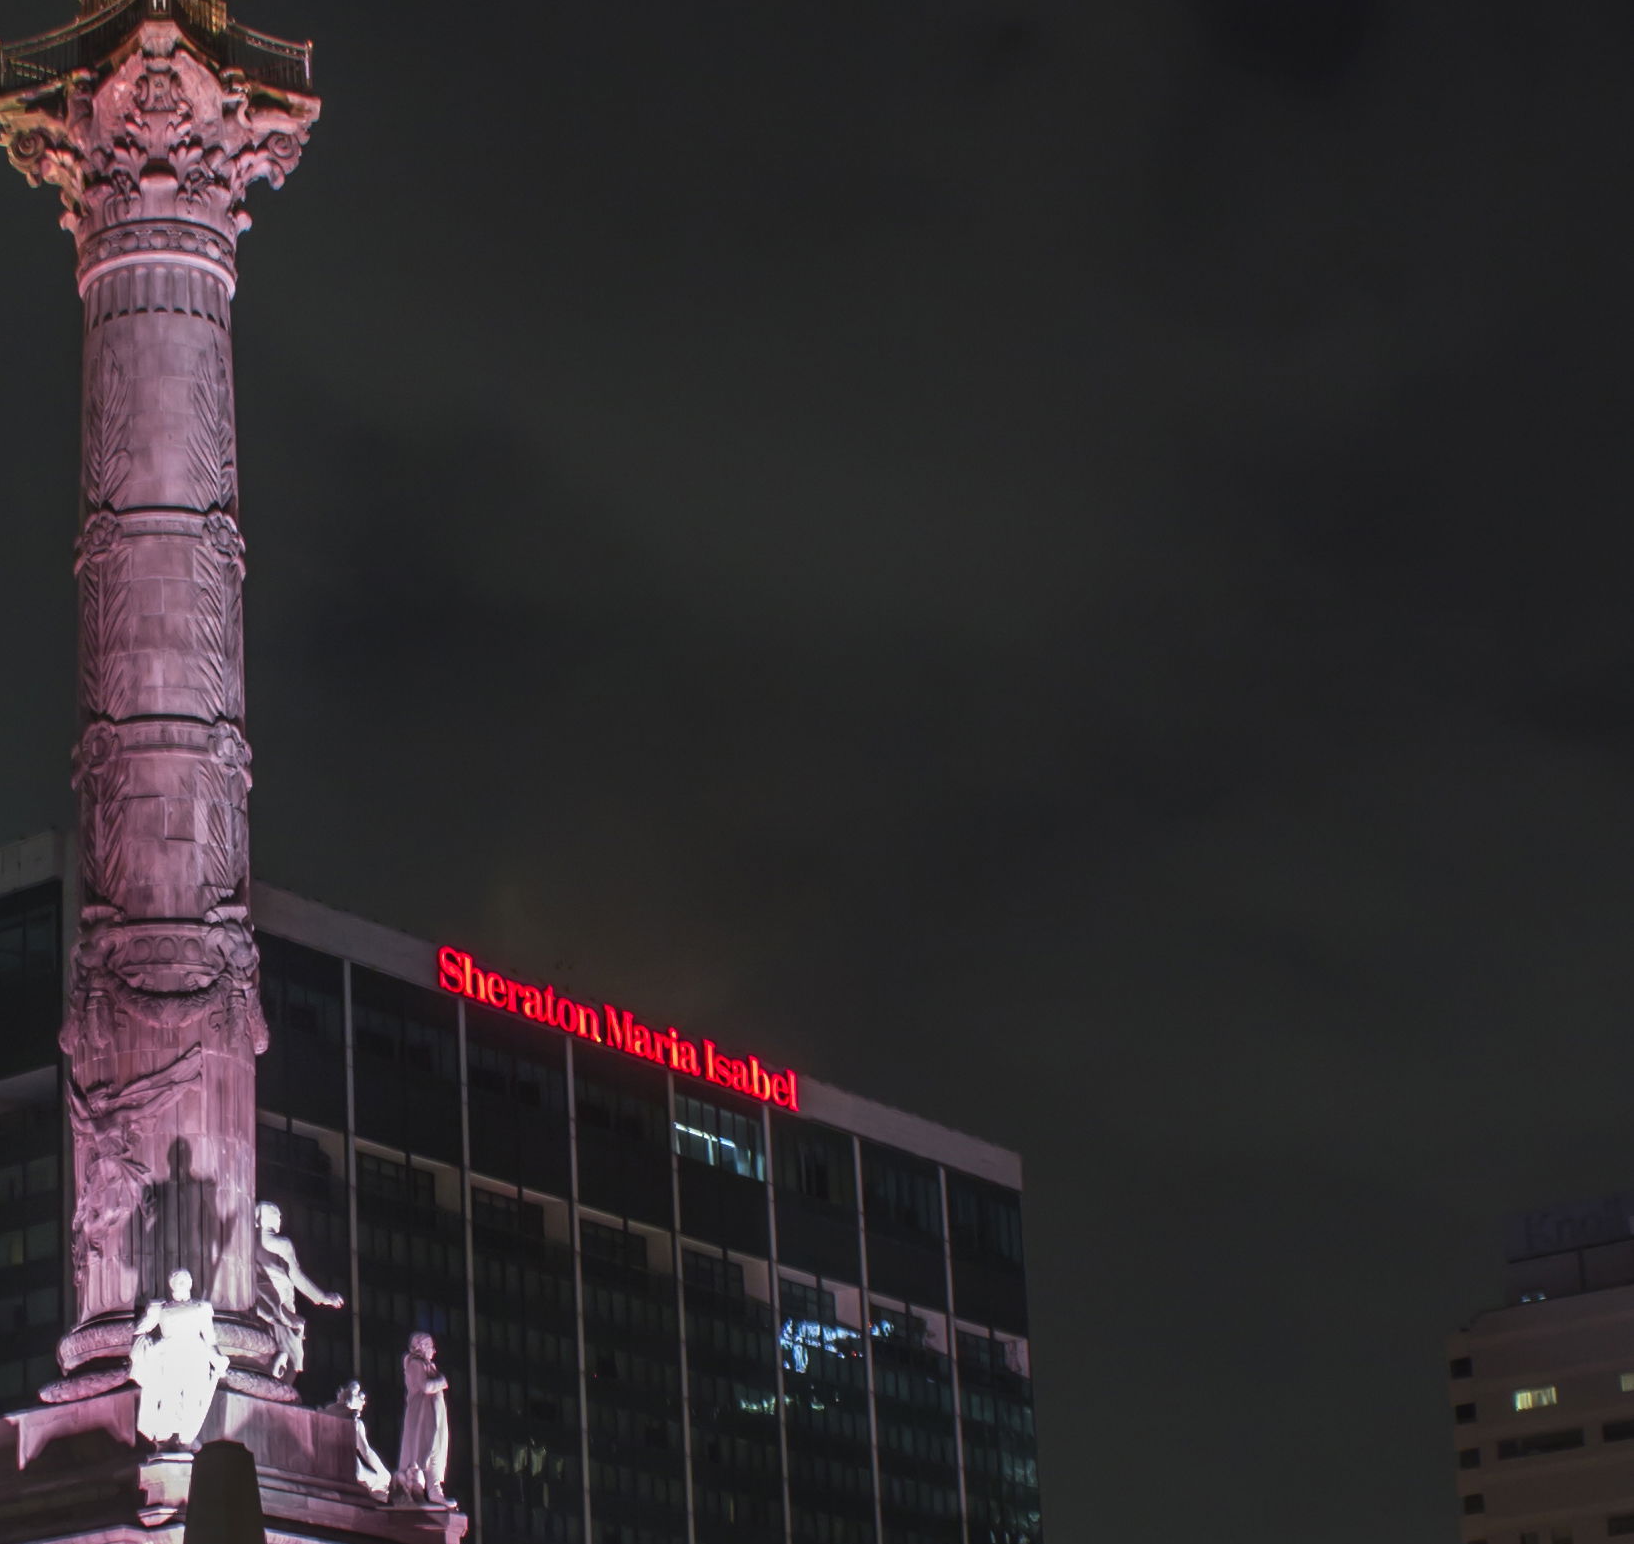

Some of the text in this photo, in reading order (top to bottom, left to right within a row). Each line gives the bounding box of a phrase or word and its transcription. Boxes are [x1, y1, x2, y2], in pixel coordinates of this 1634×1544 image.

[437, 945, 800, 1112] Sheraton Maria Isabel
